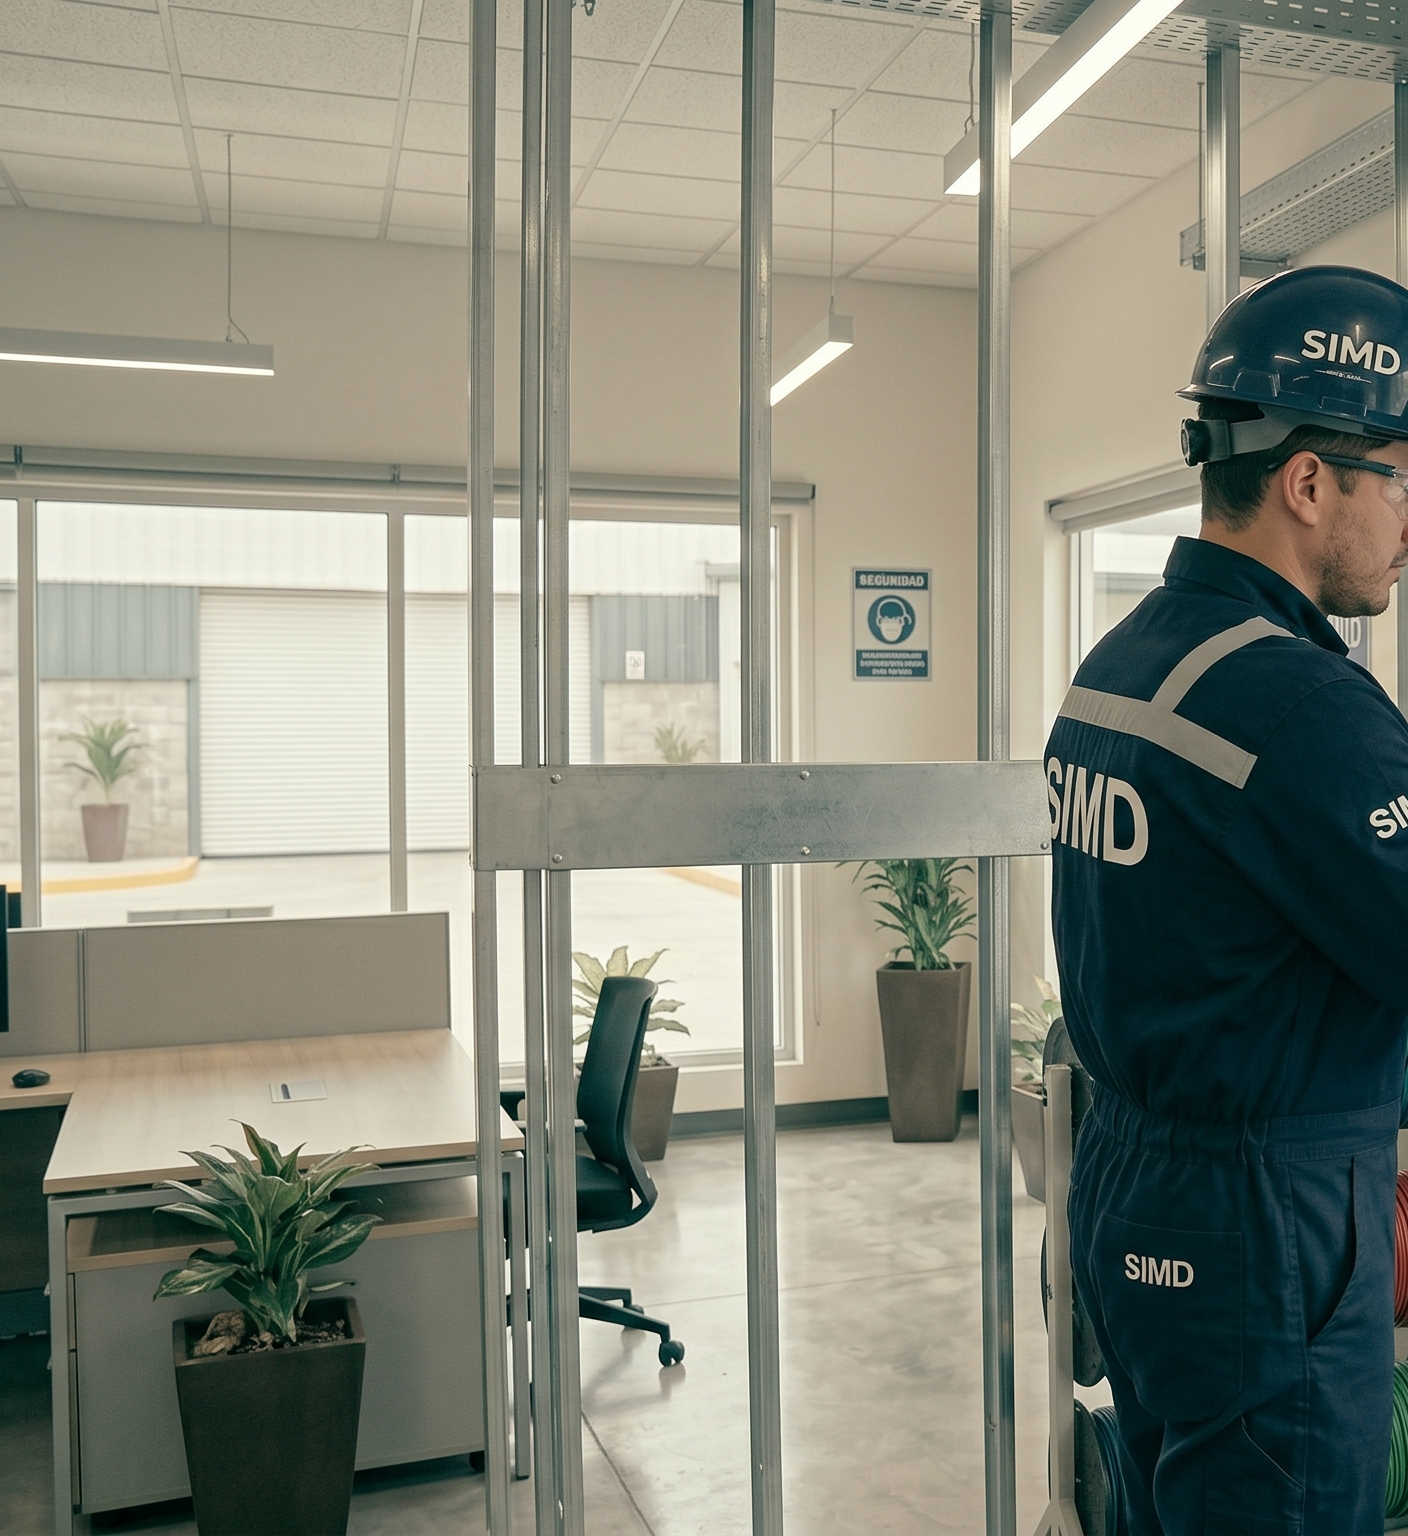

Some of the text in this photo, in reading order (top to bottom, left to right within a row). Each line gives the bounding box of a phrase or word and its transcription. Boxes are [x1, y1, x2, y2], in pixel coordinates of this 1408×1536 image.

[1301, 329, 1401, 376] SIMD
[1047, 756, 1149, 866] SIMD
[1124, 1253, 1195, 1288] SIMD
